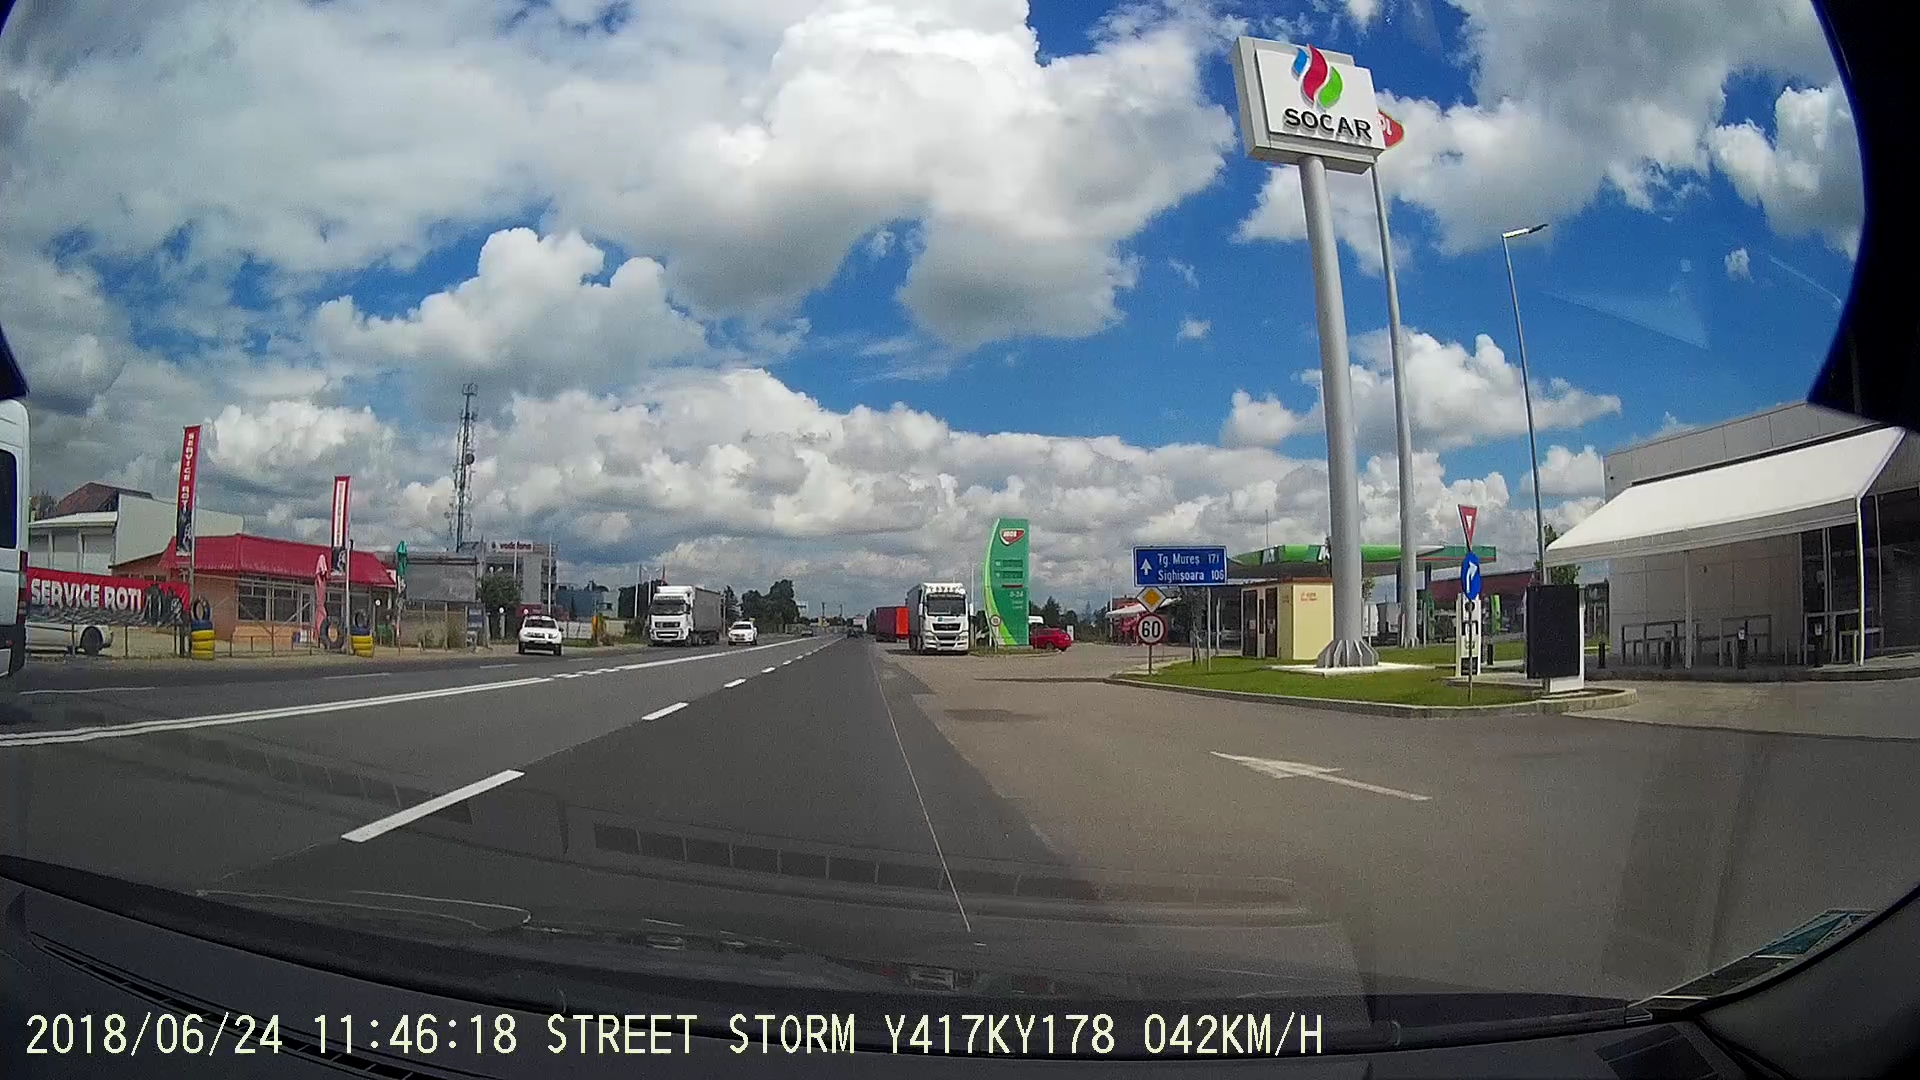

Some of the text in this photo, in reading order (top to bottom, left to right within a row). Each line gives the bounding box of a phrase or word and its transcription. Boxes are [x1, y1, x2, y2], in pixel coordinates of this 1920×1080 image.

[1284, 108, 1372, 139] SOCAR
[1208, 553, 1220, 564] 171
[1157, 569, 1224, 583] Sighișoara 106
[31, 578, 142, 613] SERVICE ROTI
[1141, 620, 1160, 638] 60
